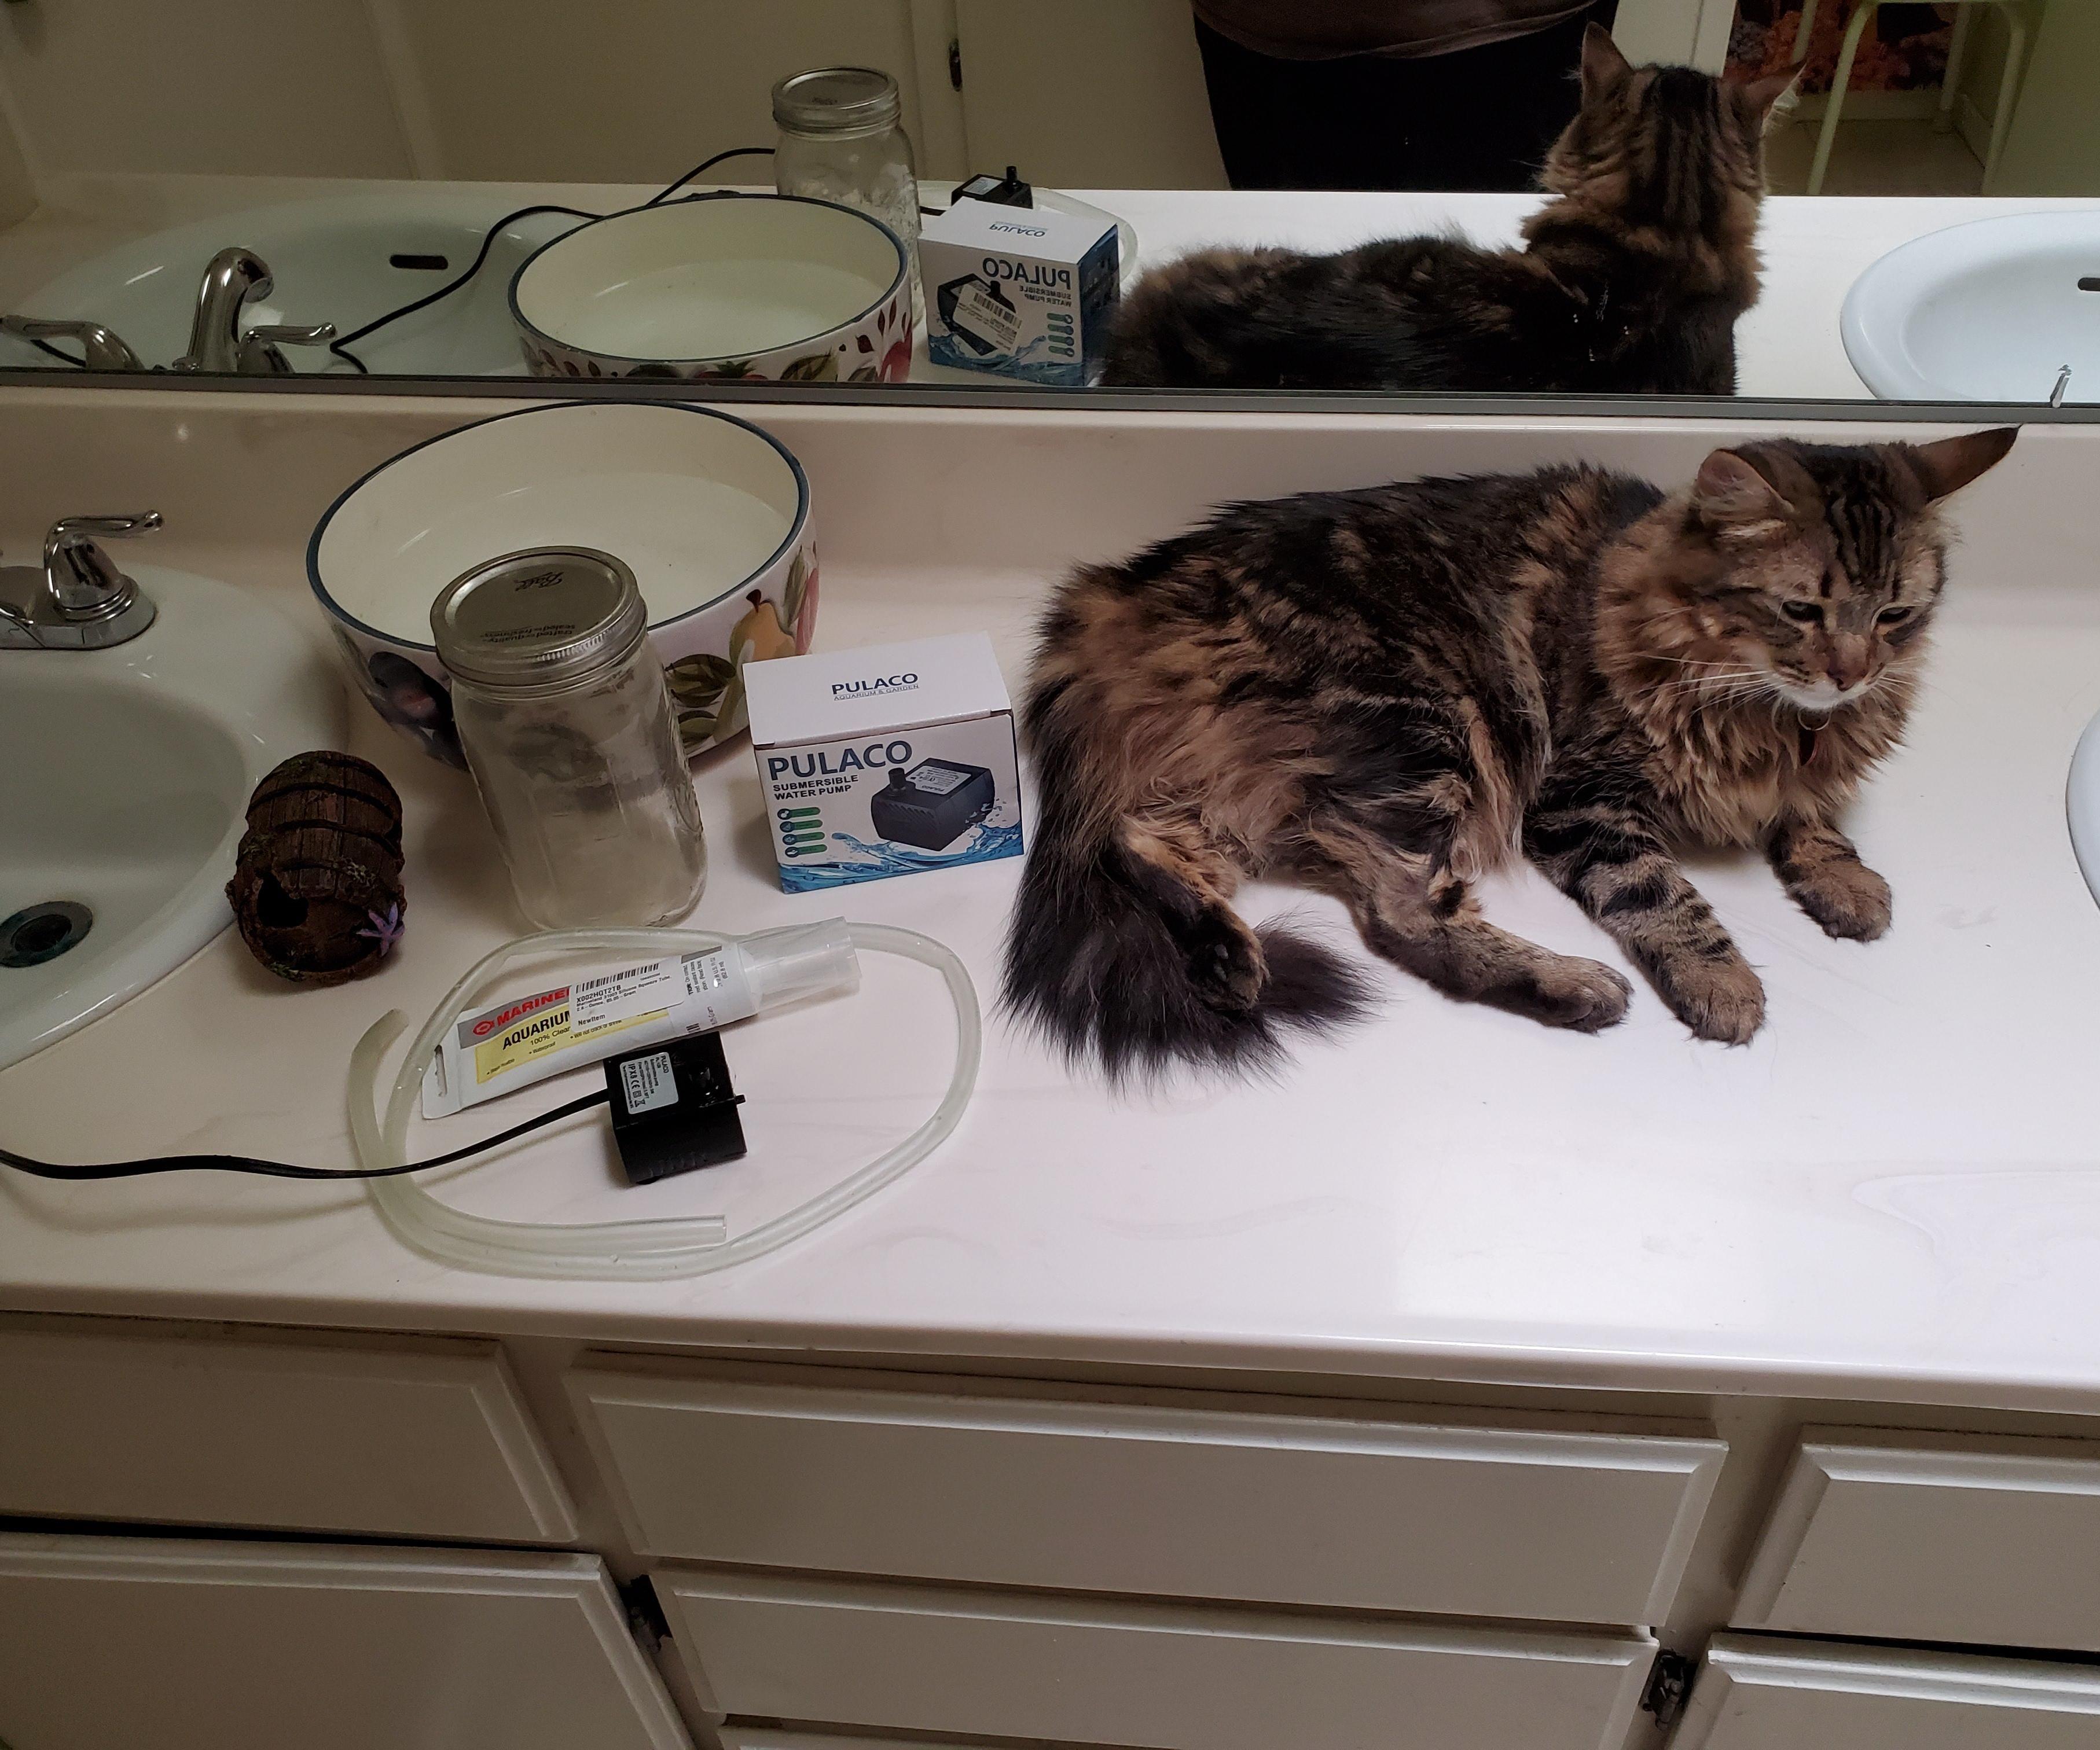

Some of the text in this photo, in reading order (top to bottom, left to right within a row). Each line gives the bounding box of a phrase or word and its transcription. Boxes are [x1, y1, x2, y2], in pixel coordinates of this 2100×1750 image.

[832, 673, 917, 695] PULACO
[834, 691, 876, 701] AQUARIUM
[886, 685, 919, 693] GARDEN
[768, 740, 912, 781] PULACO
[773, 774, 858, 792] SUBMERSIBLE
[774, 785, 851, 800] WATER PUMP
[577, 997, 603, 1006] Marineland
[531, 1027, 570, 1045] 100% Clear
[533, 1042, 556, 1053] Waterproof
[628, 1063, 638, 1079] IPX8
[661, 1055, 669, 1073] PULACO
